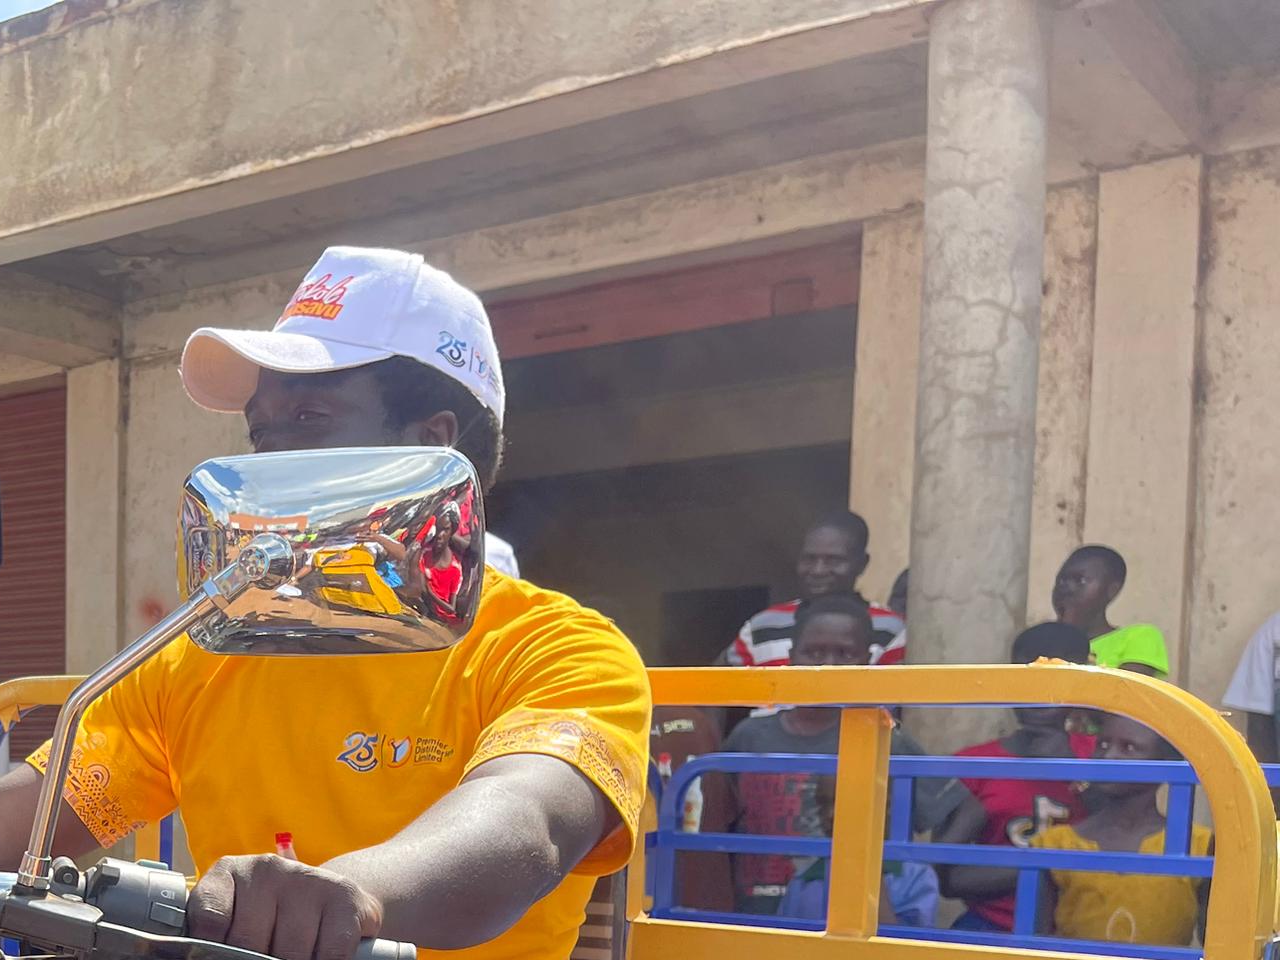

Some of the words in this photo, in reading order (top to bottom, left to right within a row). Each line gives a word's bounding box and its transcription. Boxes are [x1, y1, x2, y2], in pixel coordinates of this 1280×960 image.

[435, 331, 468, 367] 25
[336, 731, 378, 771] 25
[416, 737, 448, 750] Premier
